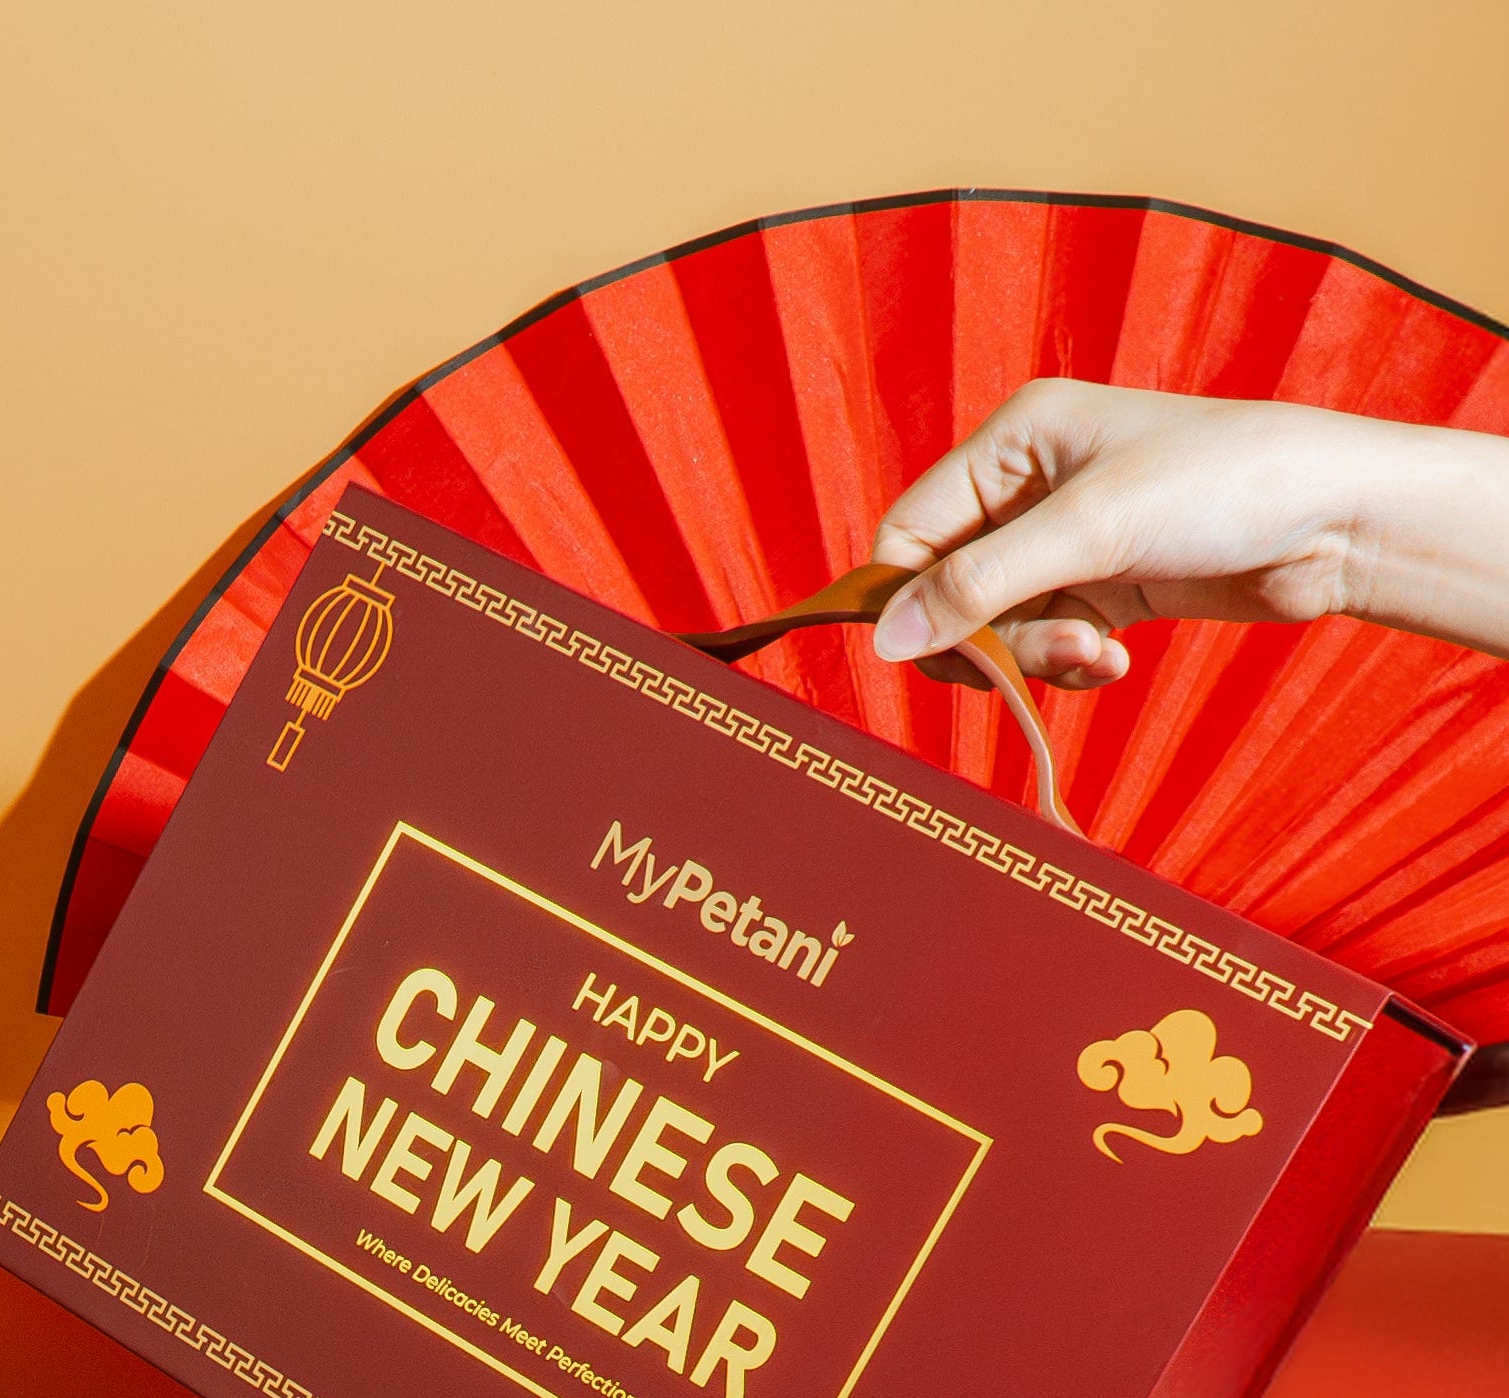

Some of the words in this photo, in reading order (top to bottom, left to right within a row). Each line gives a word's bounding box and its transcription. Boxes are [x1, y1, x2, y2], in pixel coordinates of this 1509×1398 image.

[589, 819, 854, 989] MyPetani
[571, 971, 740, 1083] HAPPY
[308, 1074, 535, 1255] NEW
[374, 966, 856, 1301] CHINESE
[356, 1228, 412, 1274] Where
[411, 1264, 500, 1327] Delicacies
[498, 1317, 548, 1356] Meet
